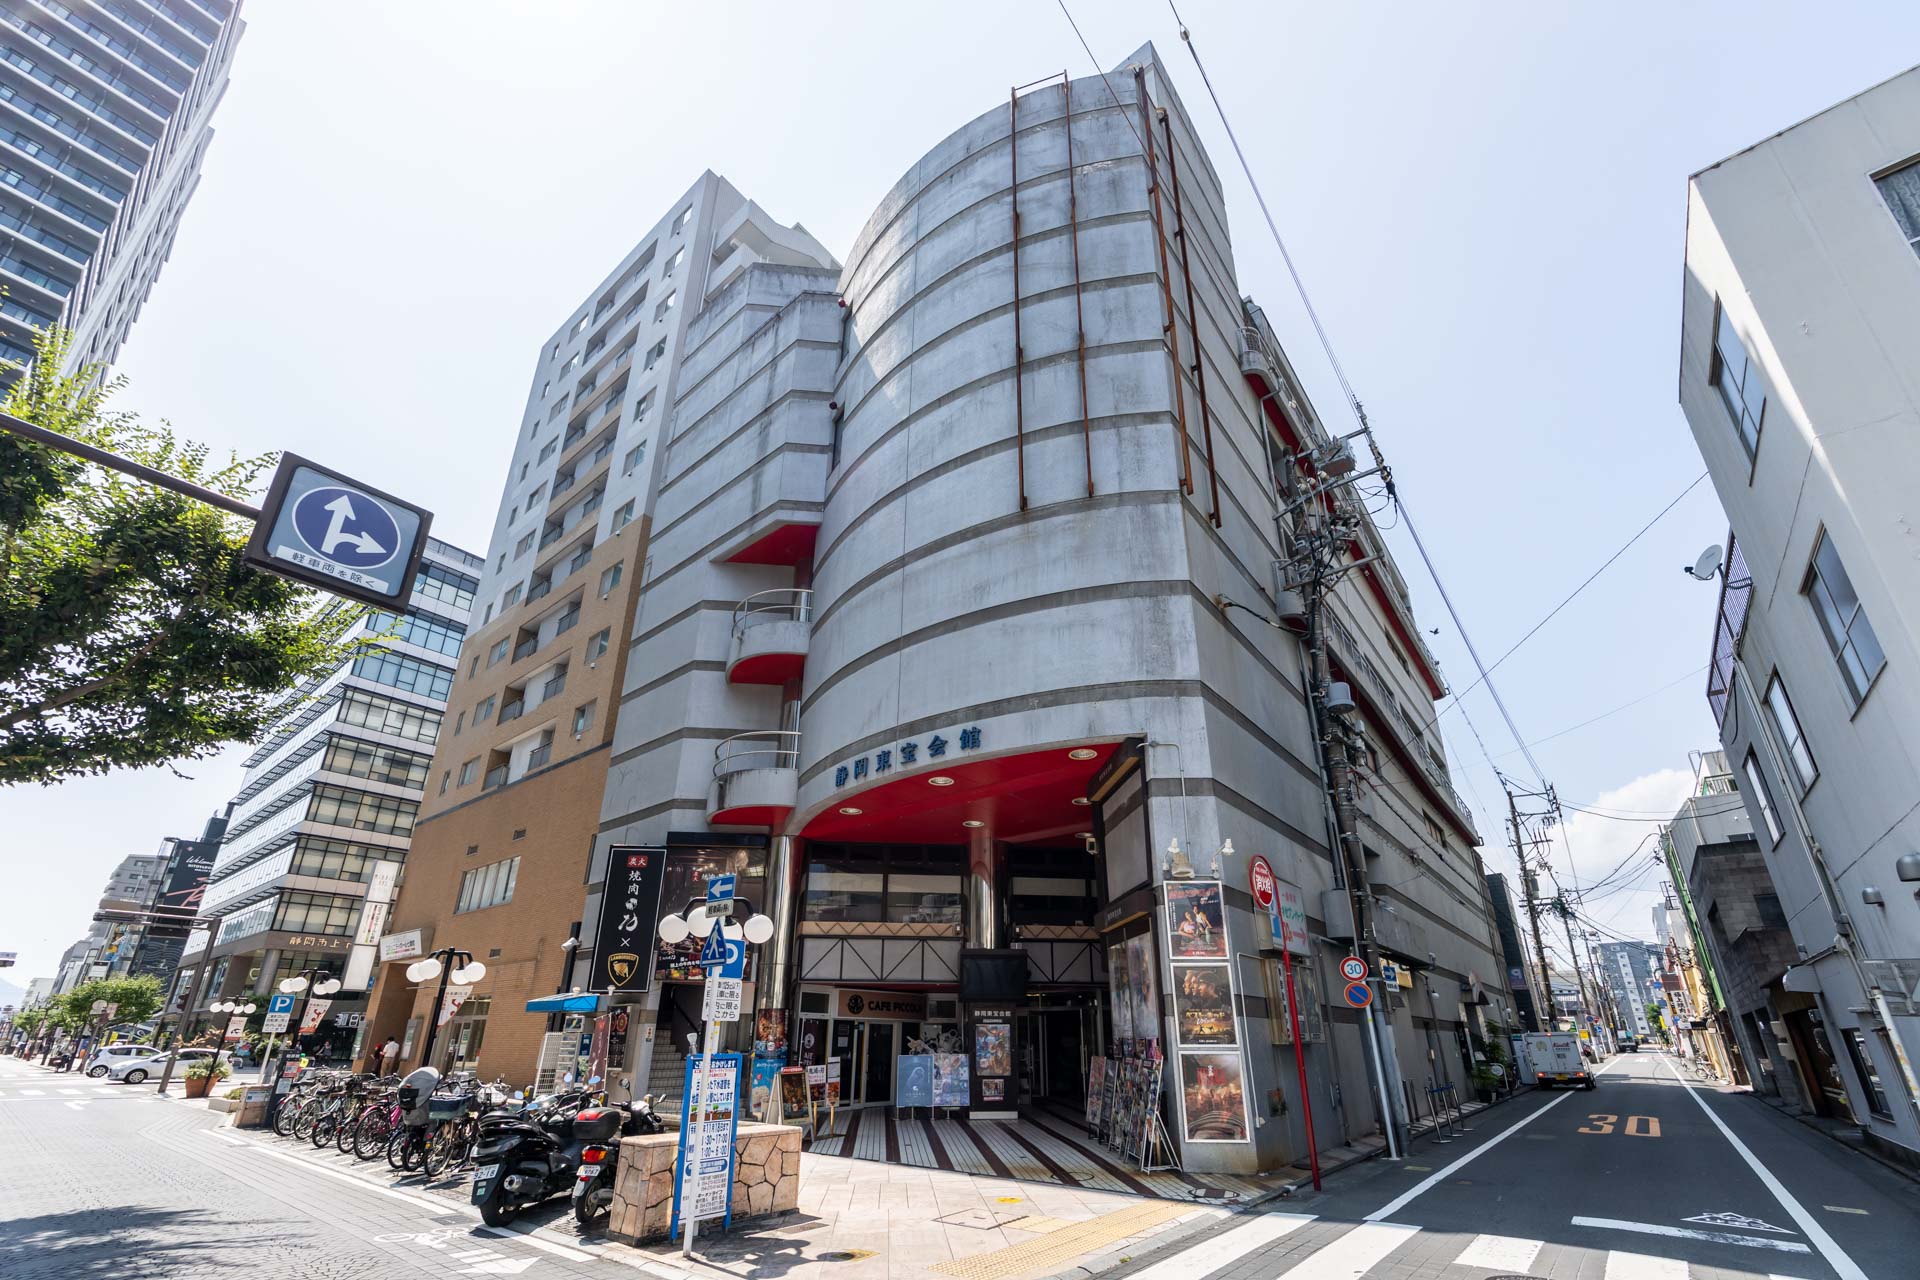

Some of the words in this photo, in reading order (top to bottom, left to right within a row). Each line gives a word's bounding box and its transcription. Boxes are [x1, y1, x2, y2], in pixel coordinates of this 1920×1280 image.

[292, 551, 376, 589] 軽車両を除く
[834, 726, 982, 788] 静岡東宝会館
[1346, 963, 1362, 975] 30
[274, 996, 291, 1012] P
[868, 1000, 891, 1011] CAFE
[1577, 1114, 1662, 1138] 30
